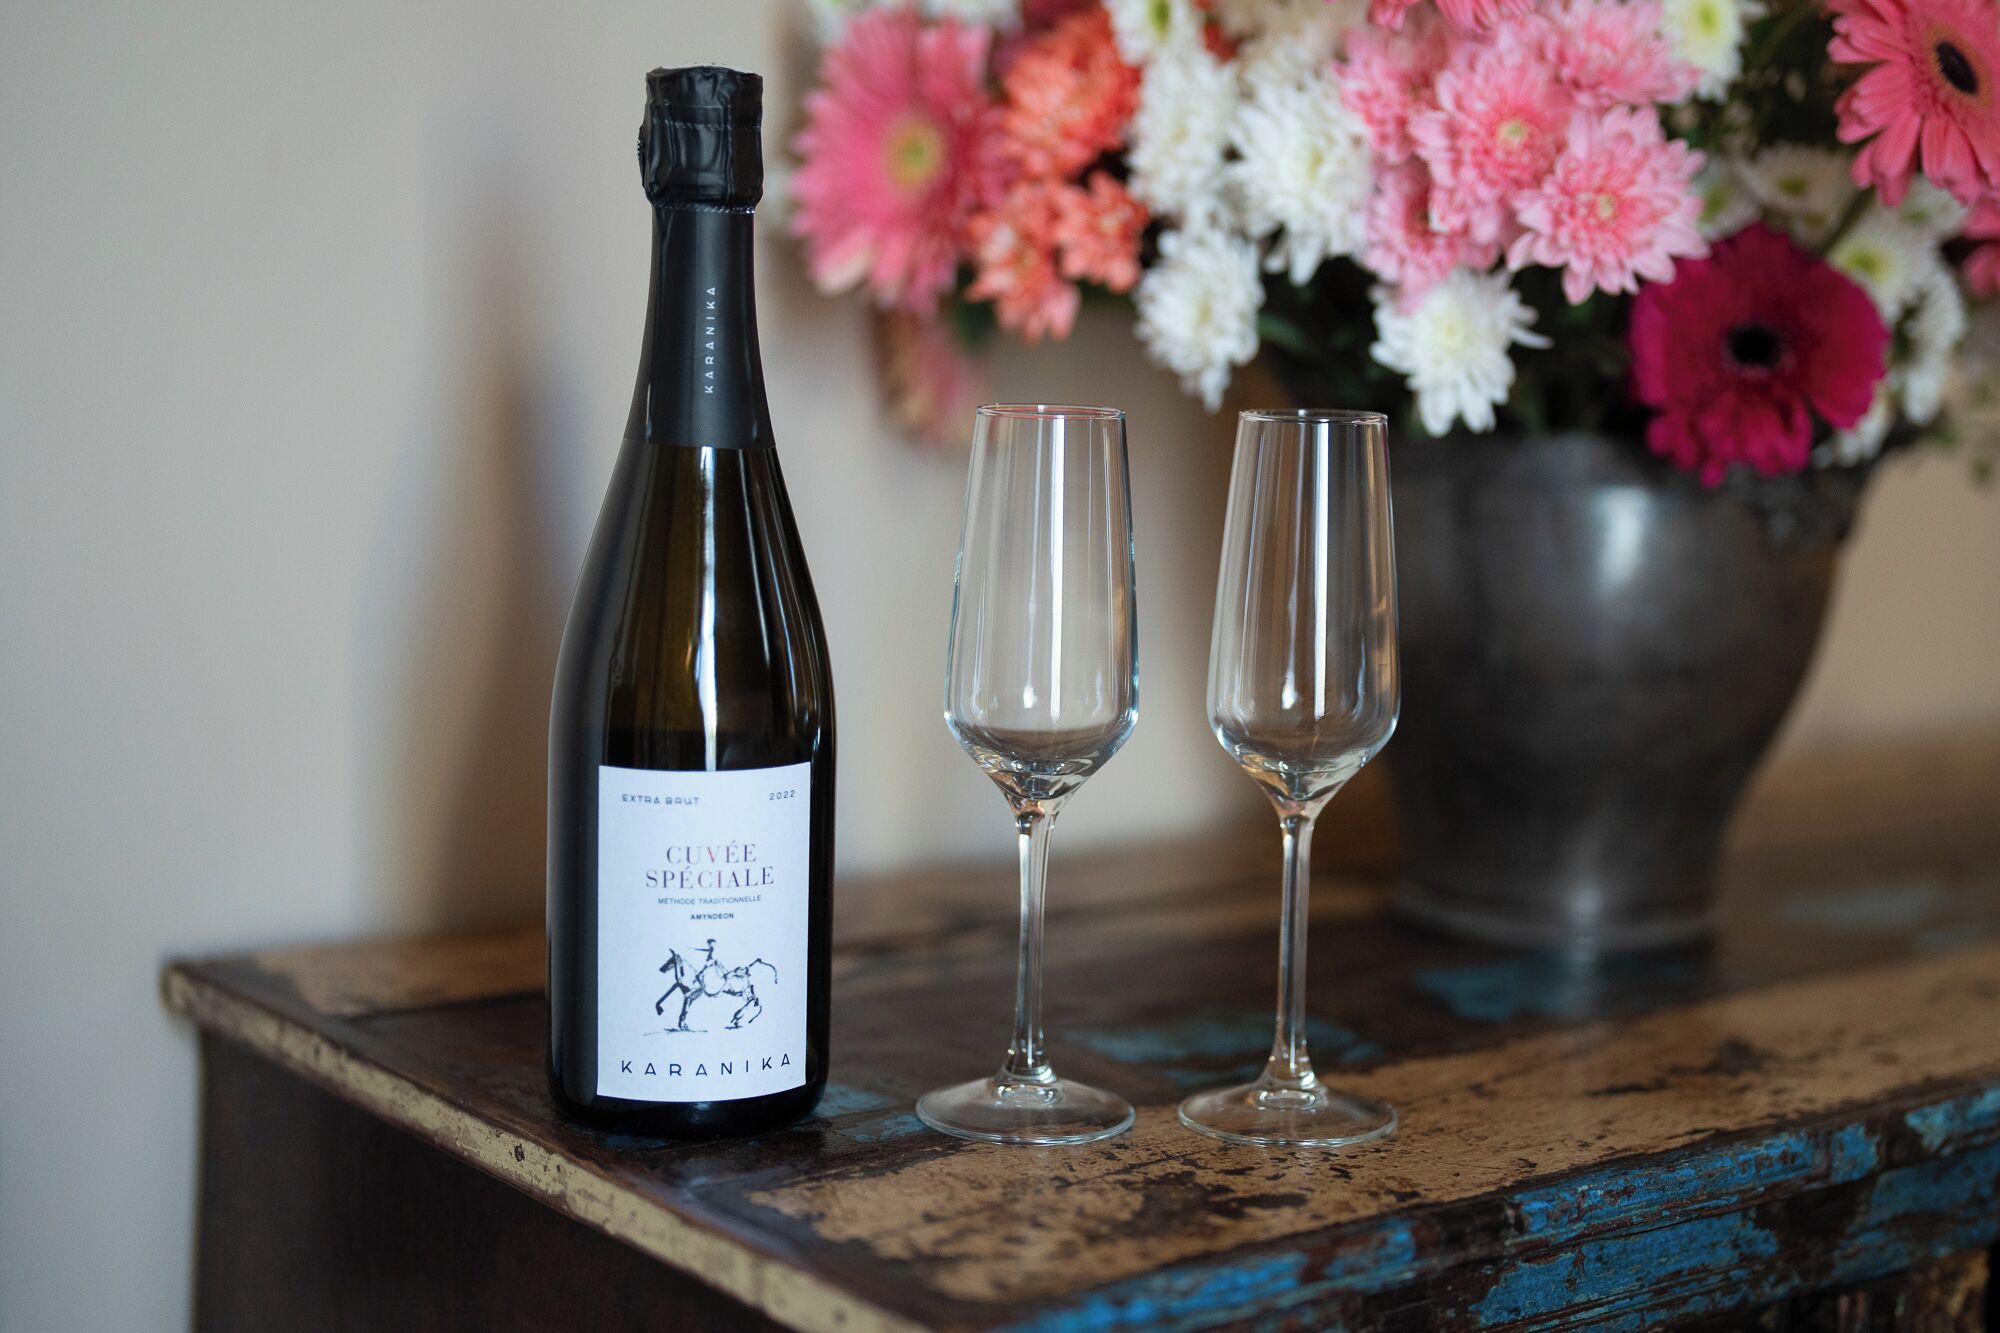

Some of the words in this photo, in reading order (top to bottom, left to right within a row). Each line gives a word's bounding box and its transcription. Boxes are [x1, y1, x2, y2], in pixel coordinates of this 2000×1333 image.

[704, 287, 716, 394] KARANIKA
[621, 793, 661, 805] EXTRA
[664, 795, 701, 806] BRUT
[768, 789, 796, 801] 2022
[665, 840, 757, 865] CUVÉE
[645, 866, 775, 889] SPÉCIALE
[657, 895, 696, 905] MÉTHODE
[698, 894, 762, 905] TRADITIONNELLE
[690, 912, 735, 920] AMYNDEON
[621, 1053, 791, 1077] KARANIKA
